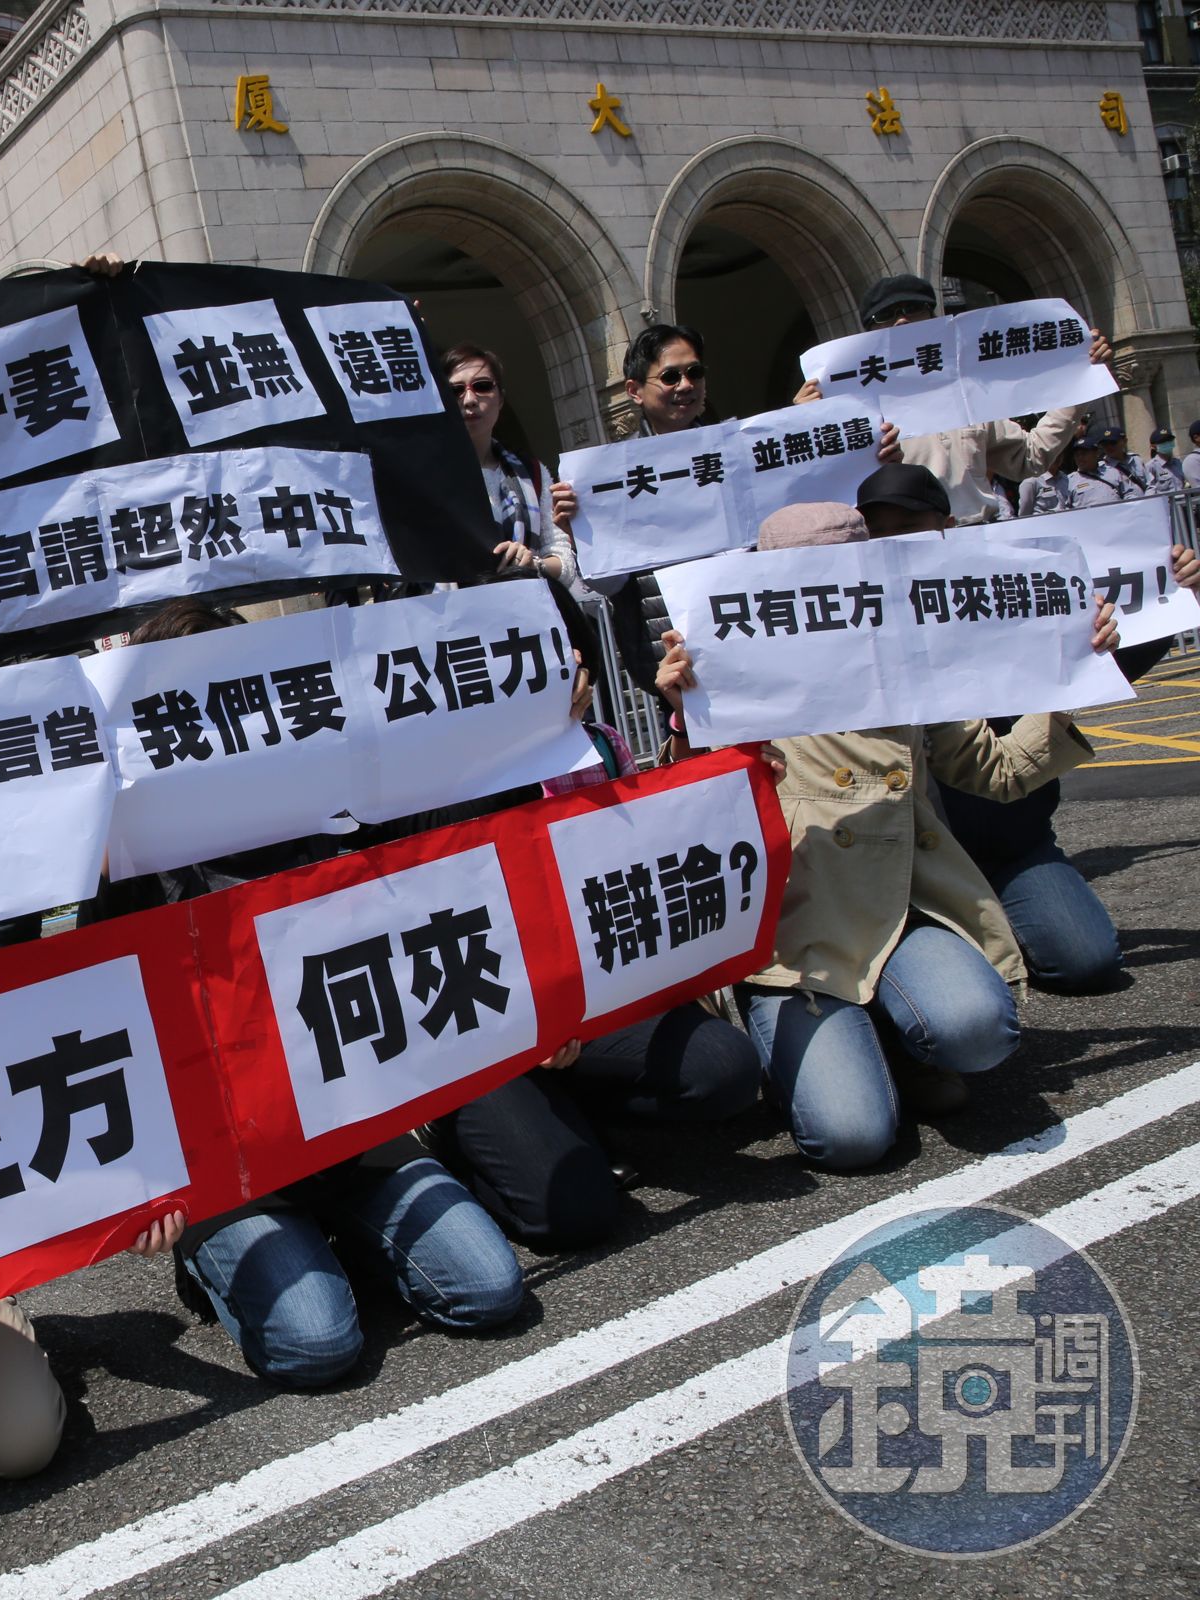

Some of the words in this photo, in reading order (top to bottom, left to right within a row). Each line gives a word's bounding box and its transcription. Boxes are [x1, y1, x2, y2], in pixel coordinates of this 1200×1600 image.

[173, 332, 303, 415] 並無
[329, 326, 426, 396] 違憲
[831, 343, 943, 386] 一夫一妻
[978, 318, 1084, 362] 並無違憲
[592, 452, 724, 499] 一夫一妻
[752, 417, 875, 472] 並無違憲
[710, 582, 883, 640] 只有正方
[909, 572, 1086, 624] 何來辯論?
[132, 661, 346, 769] 我們要
[296, 905, 510, 1083] 何來
[582, 841, 758, 974] 辯論?
